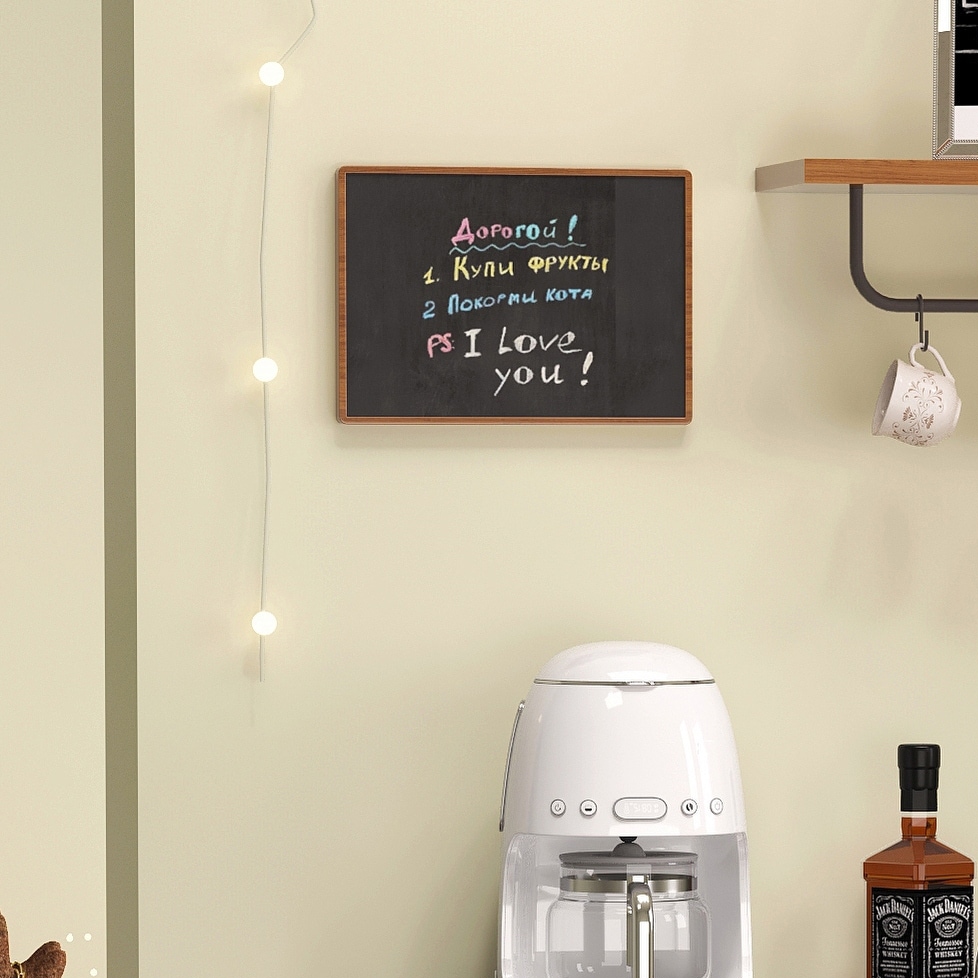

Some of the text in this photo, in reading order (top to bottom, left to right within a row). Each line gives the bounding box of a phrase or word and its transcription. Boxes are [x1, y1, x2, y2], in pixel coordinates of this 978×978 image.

[422, 301, 435, 319] 2
[463, 328, 482, 358] I
[876, 902, 891, 920] JACK
[927, 902, 944, 922] JACK
[934, 950, 963, 958] WHISKEY
